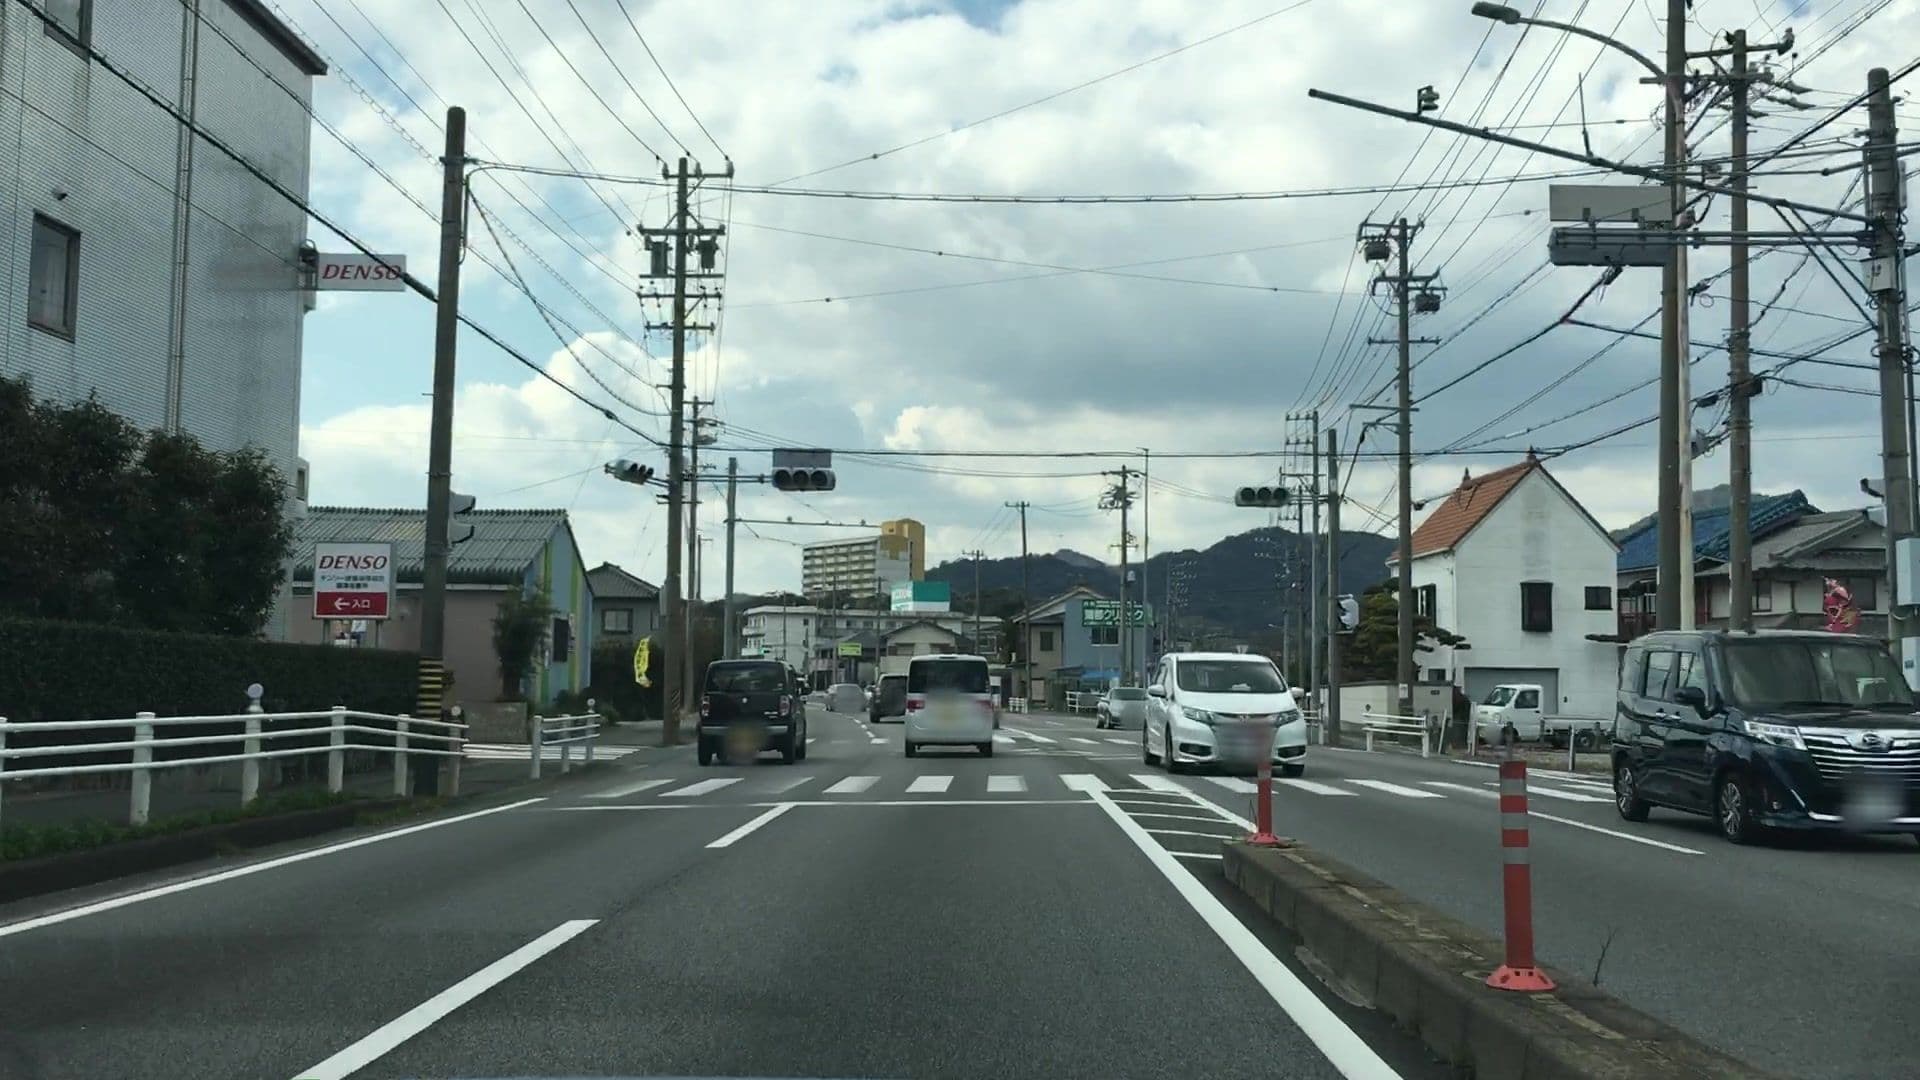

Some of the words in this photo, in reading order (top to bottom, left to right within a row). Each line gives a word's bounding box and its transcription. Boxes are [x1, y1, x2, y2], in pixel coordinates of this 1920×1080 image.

[322, 264, 401, 280] DENSO
[319, 555, 388, 569] DENSO
[351, 599, 370, 608] 入口
